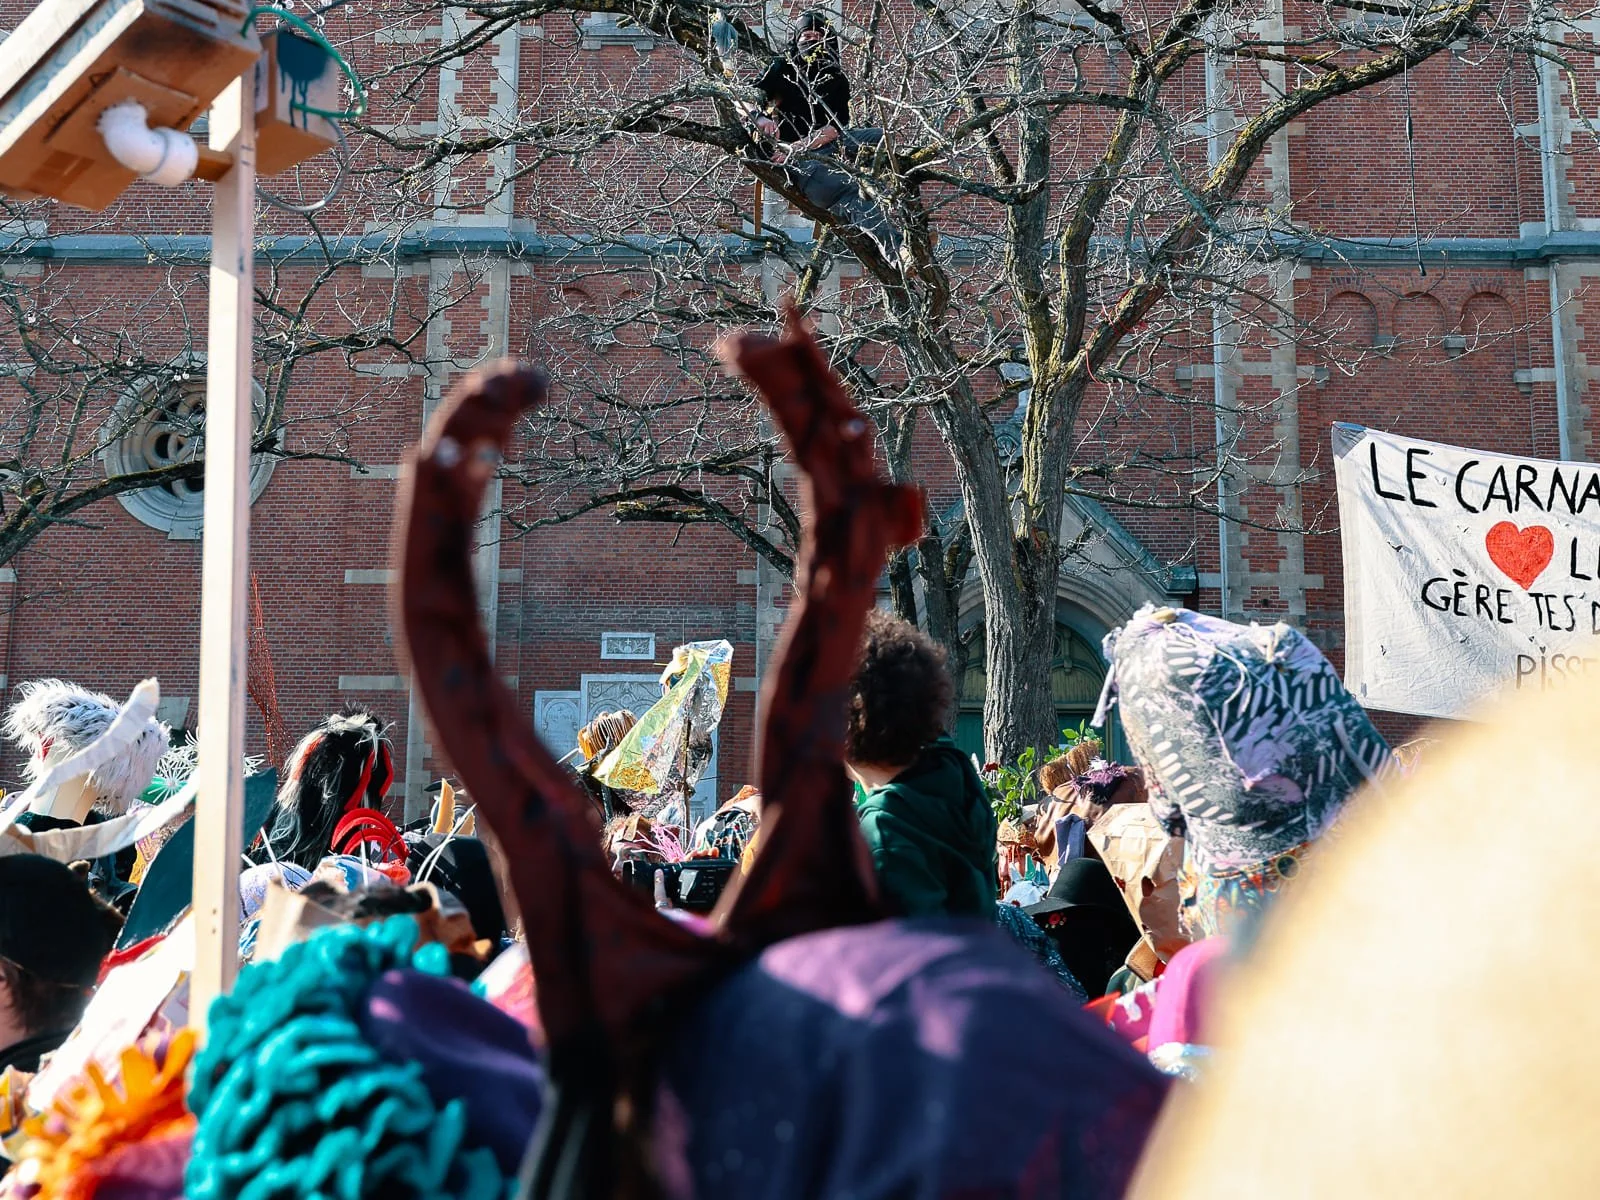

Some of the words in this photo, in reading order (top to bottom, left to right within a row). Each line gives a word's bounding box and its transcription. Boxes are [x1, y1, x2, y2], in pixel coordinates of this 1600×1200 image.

[1369, 442, 1437, 508] LE
[1455, 460, 1600, 515] CARNA
[1421, 568, 1514, 624] GÈRE
[1528, 592, 1576, 632] TES
